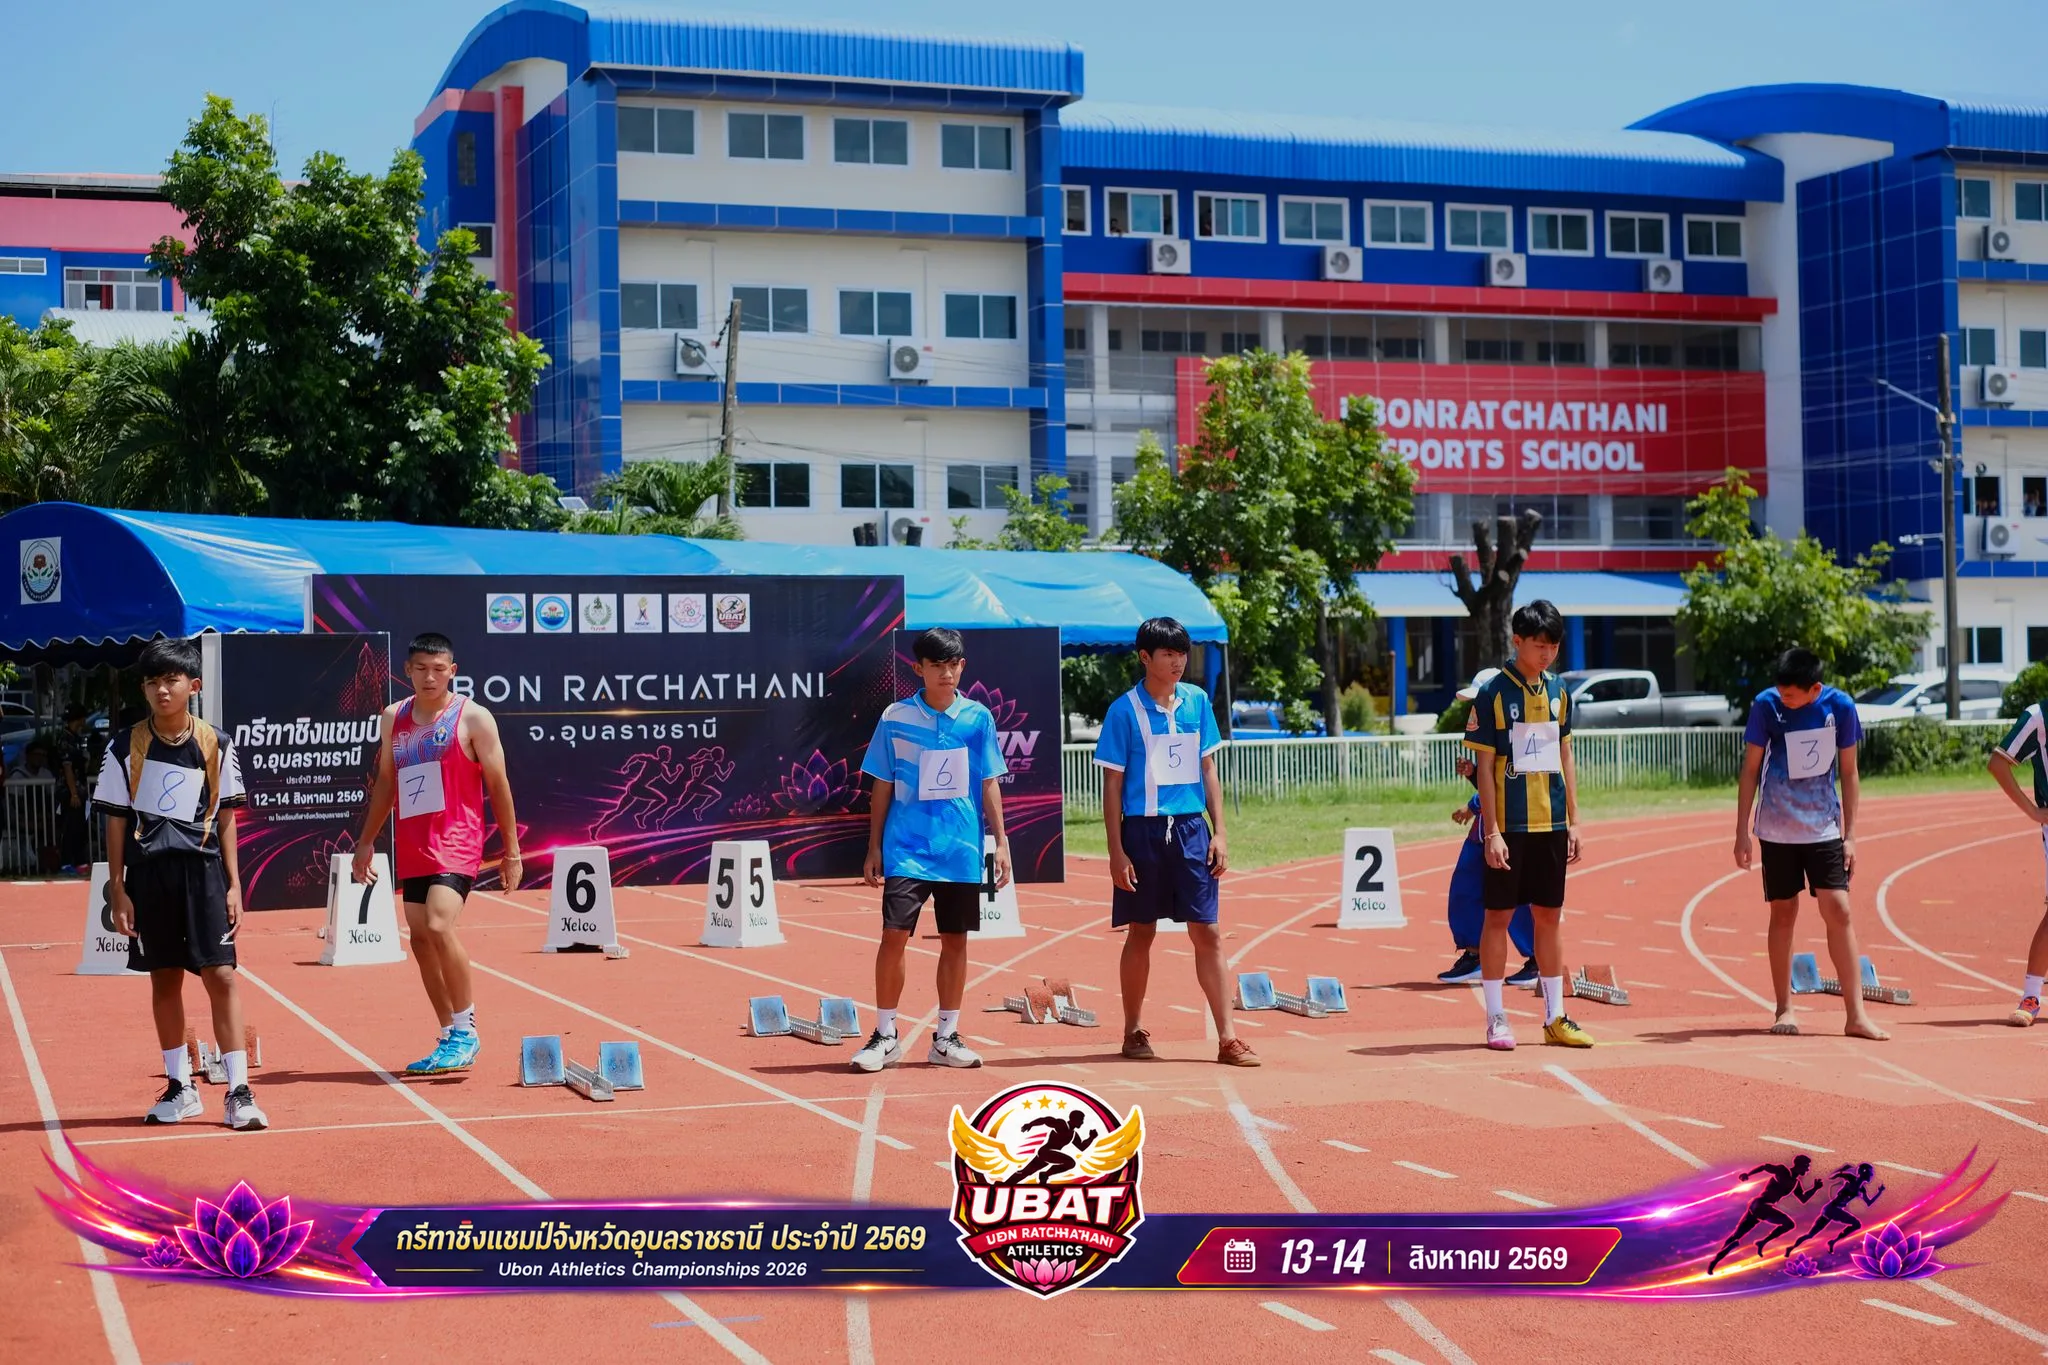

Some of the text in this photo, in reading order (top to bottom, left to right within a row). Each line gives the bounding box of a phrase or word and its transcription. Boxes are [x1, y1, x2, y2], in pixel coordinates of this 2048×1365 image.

[1521, 440, 1644, 472] SCHOOL
[451, 671, 826, 703] BON RATCHATHANI
[529, 717, 717, 748] จ.อุบลราชธานี
[1524, 732, 1542, 761] 4
[252, 745, 362, 774] จ.อุบลราชธานี
[1168, 743, 1182, 769] 5
[1800, 739, 1819, 771] 3
[313, 774, 331, 783] 2569
[935, 758, 953, 786] 6
[157, 770, 186, 812] 8
[254, 790, 364, 806] 12-14 สิงหาคม 2569
[405, 775, 426, 805] 7
[749, 857, 765, 908] 5
[1355, 845, 1384, 892] 2
[350, 870, 379, 925] 7
[566, 861, 597, 914] 6
[715, 857, 735, 910] 5
[1352, 897, 1386, 911] Nelco
[561, 917, 598, 933] Nelco
[711, 912, 733, 929] Nelco
[749, 912, 768, 928] Nelco
[348, 929, 382, 944] Nelco
